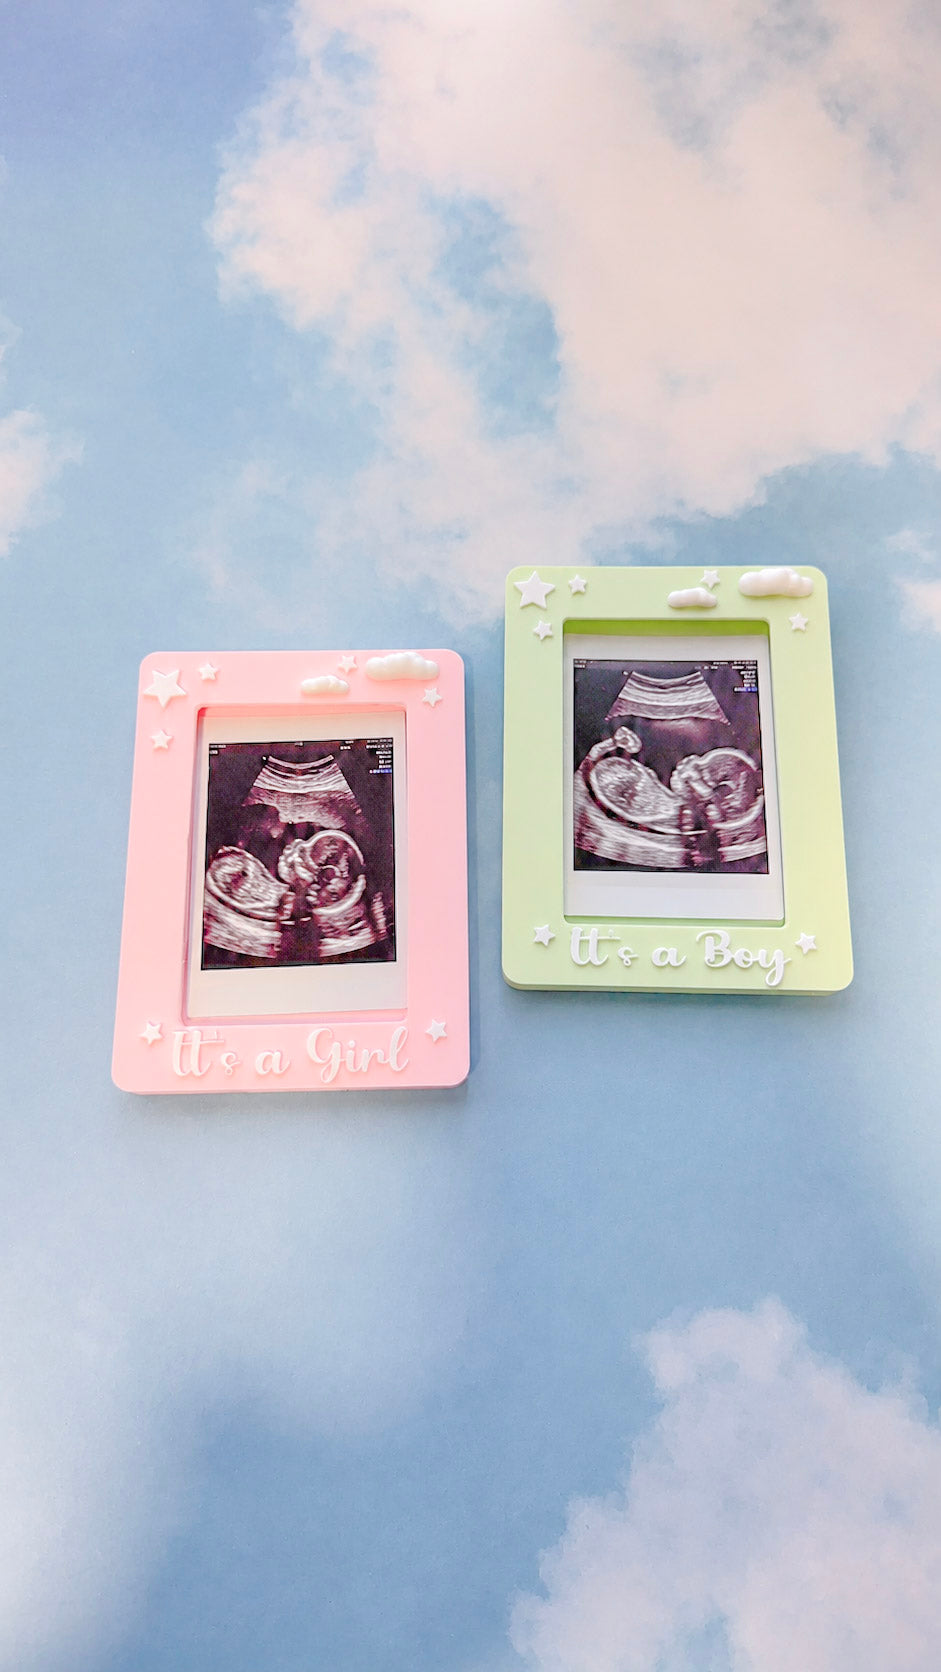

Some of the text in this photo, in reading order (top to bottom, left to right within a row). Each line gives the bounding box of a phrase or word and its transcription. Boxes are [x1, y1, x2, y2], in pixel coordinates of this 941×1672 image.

[570, 926, 792, 987] It's a Boy
[171, 1026, 409, 1083] It's a Girl
